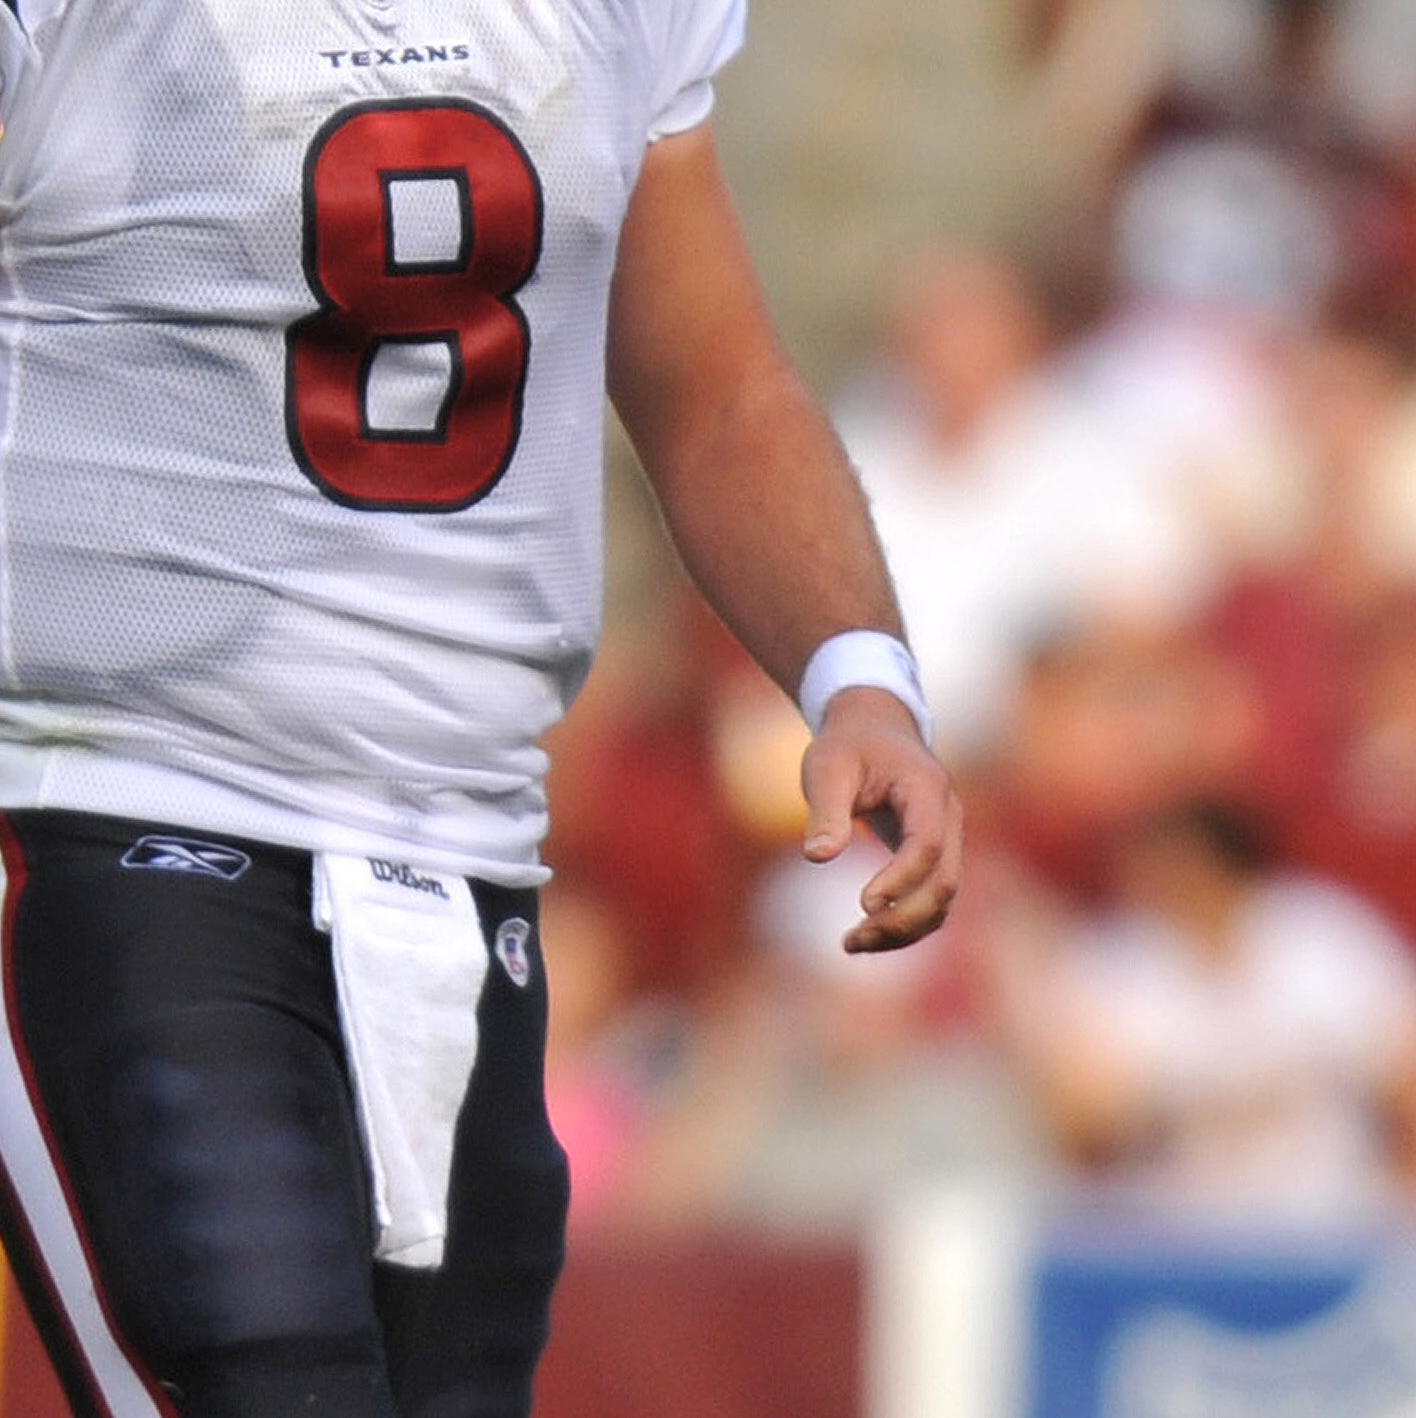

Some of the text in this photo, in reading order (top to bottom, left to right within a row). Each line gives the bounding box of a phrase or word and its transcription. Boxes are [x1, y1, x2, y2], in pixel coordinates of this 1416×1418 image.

[319, 44, 470, 68] TEXANS
[284, 95, 544, 514] 8
[366, 856, 451, 901] Wilson
